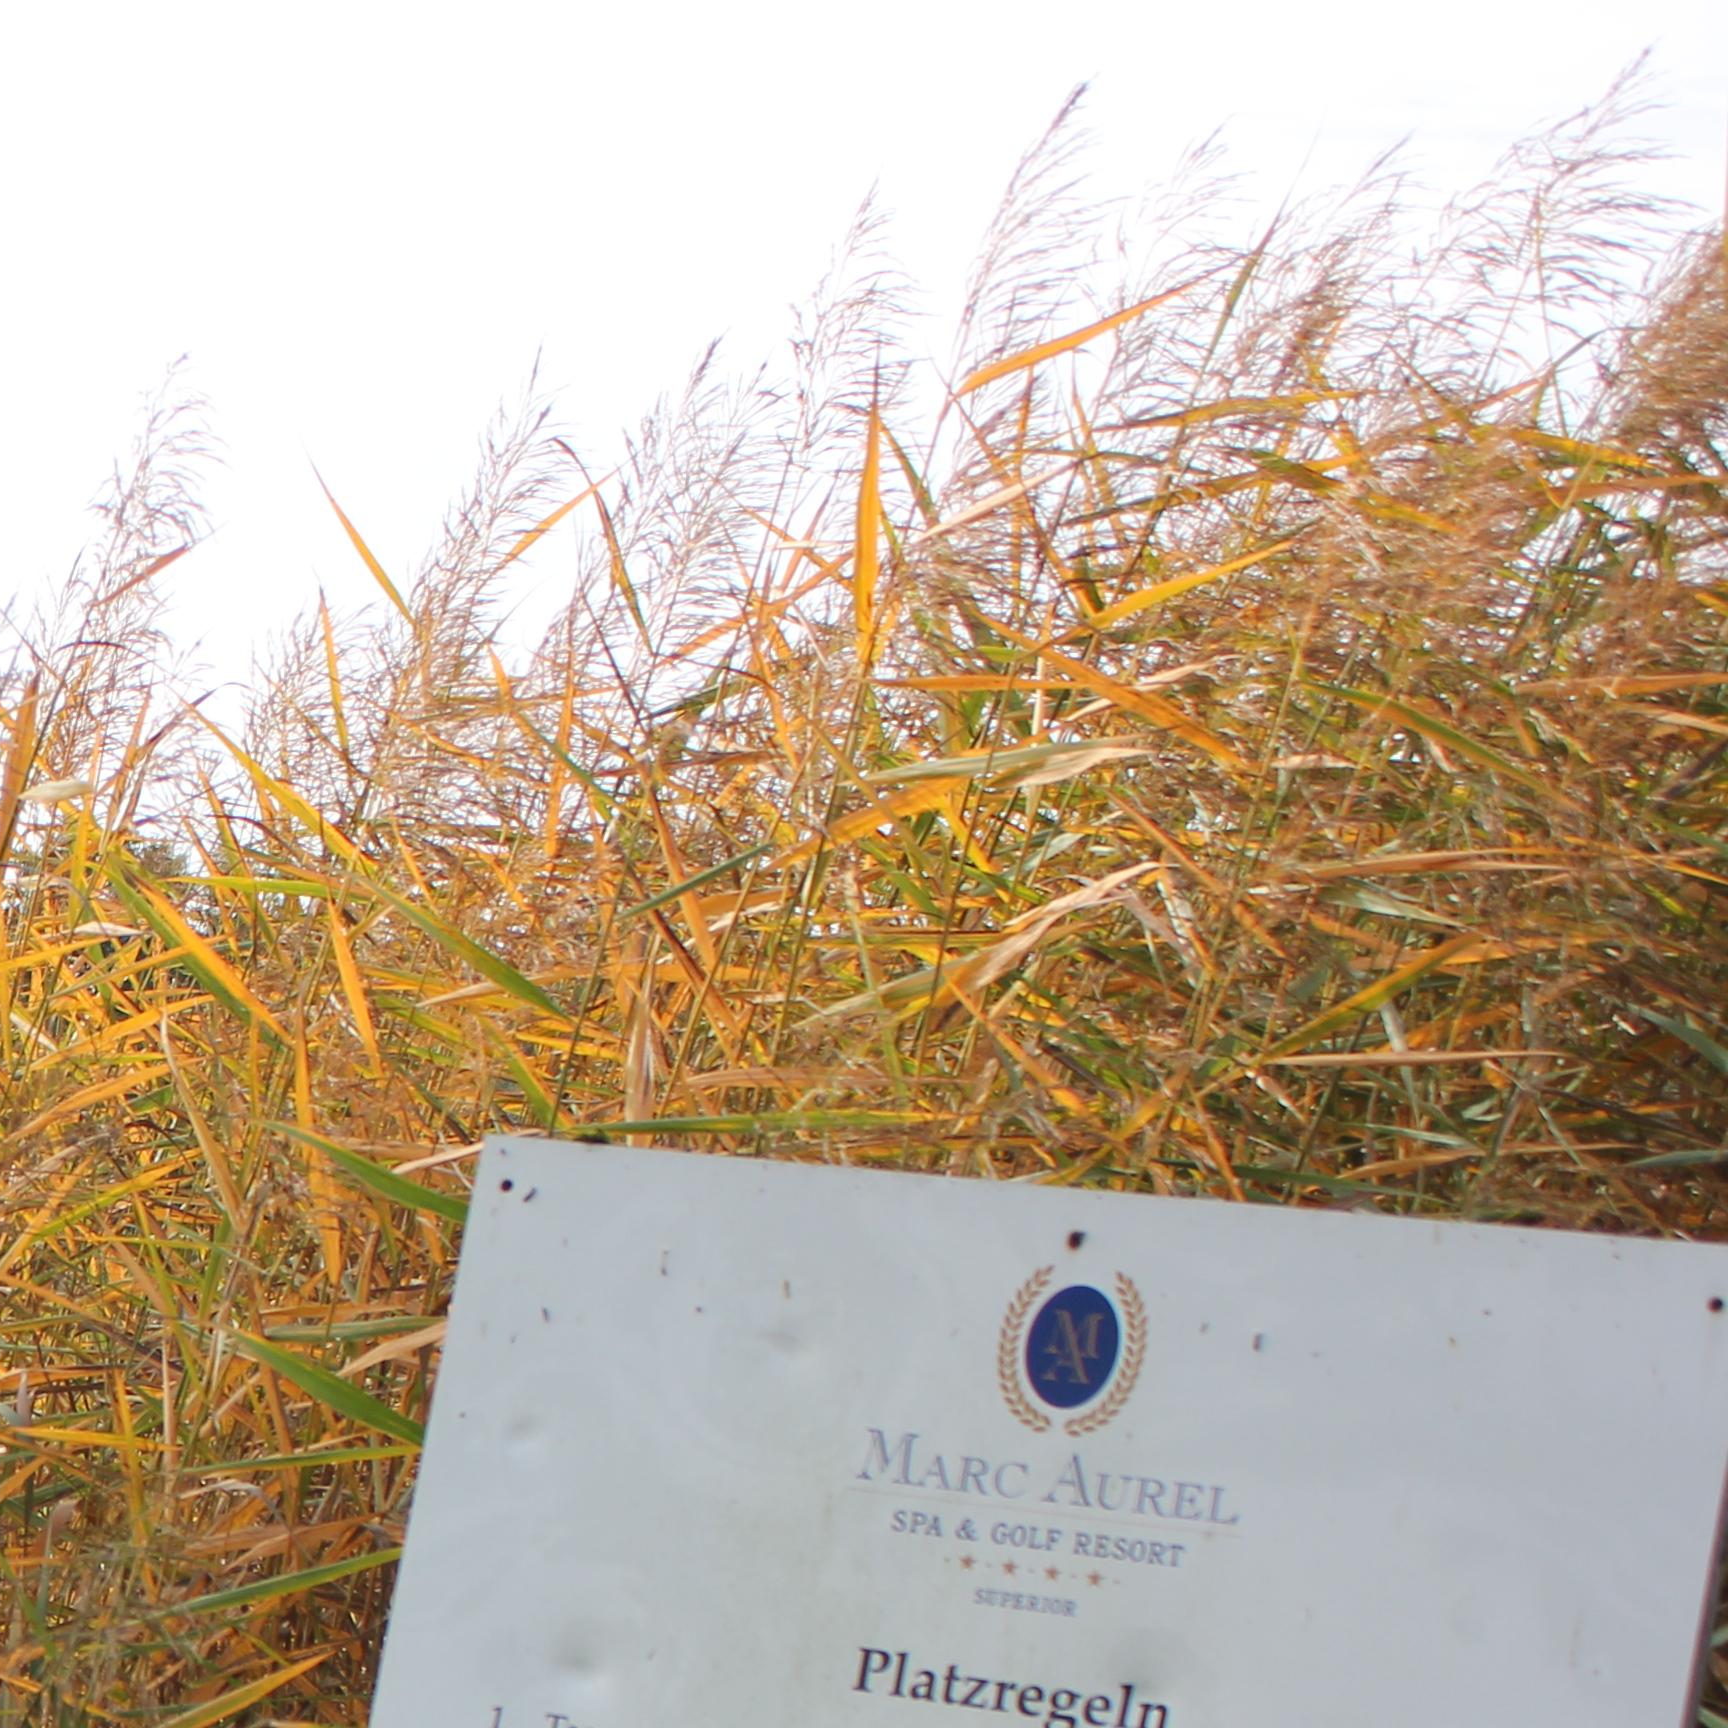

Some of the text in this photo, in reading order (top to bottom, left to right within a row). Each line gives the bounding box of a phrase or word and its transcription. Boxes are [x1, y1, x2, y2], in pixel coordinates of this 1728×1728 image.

[855, 1427, 1240, 1525] MARC AUREL
[891, 1509, 1185, 1567] SPA & GOLF RESORT
[972, 1587, 1077, 1617] SUPERIOR
